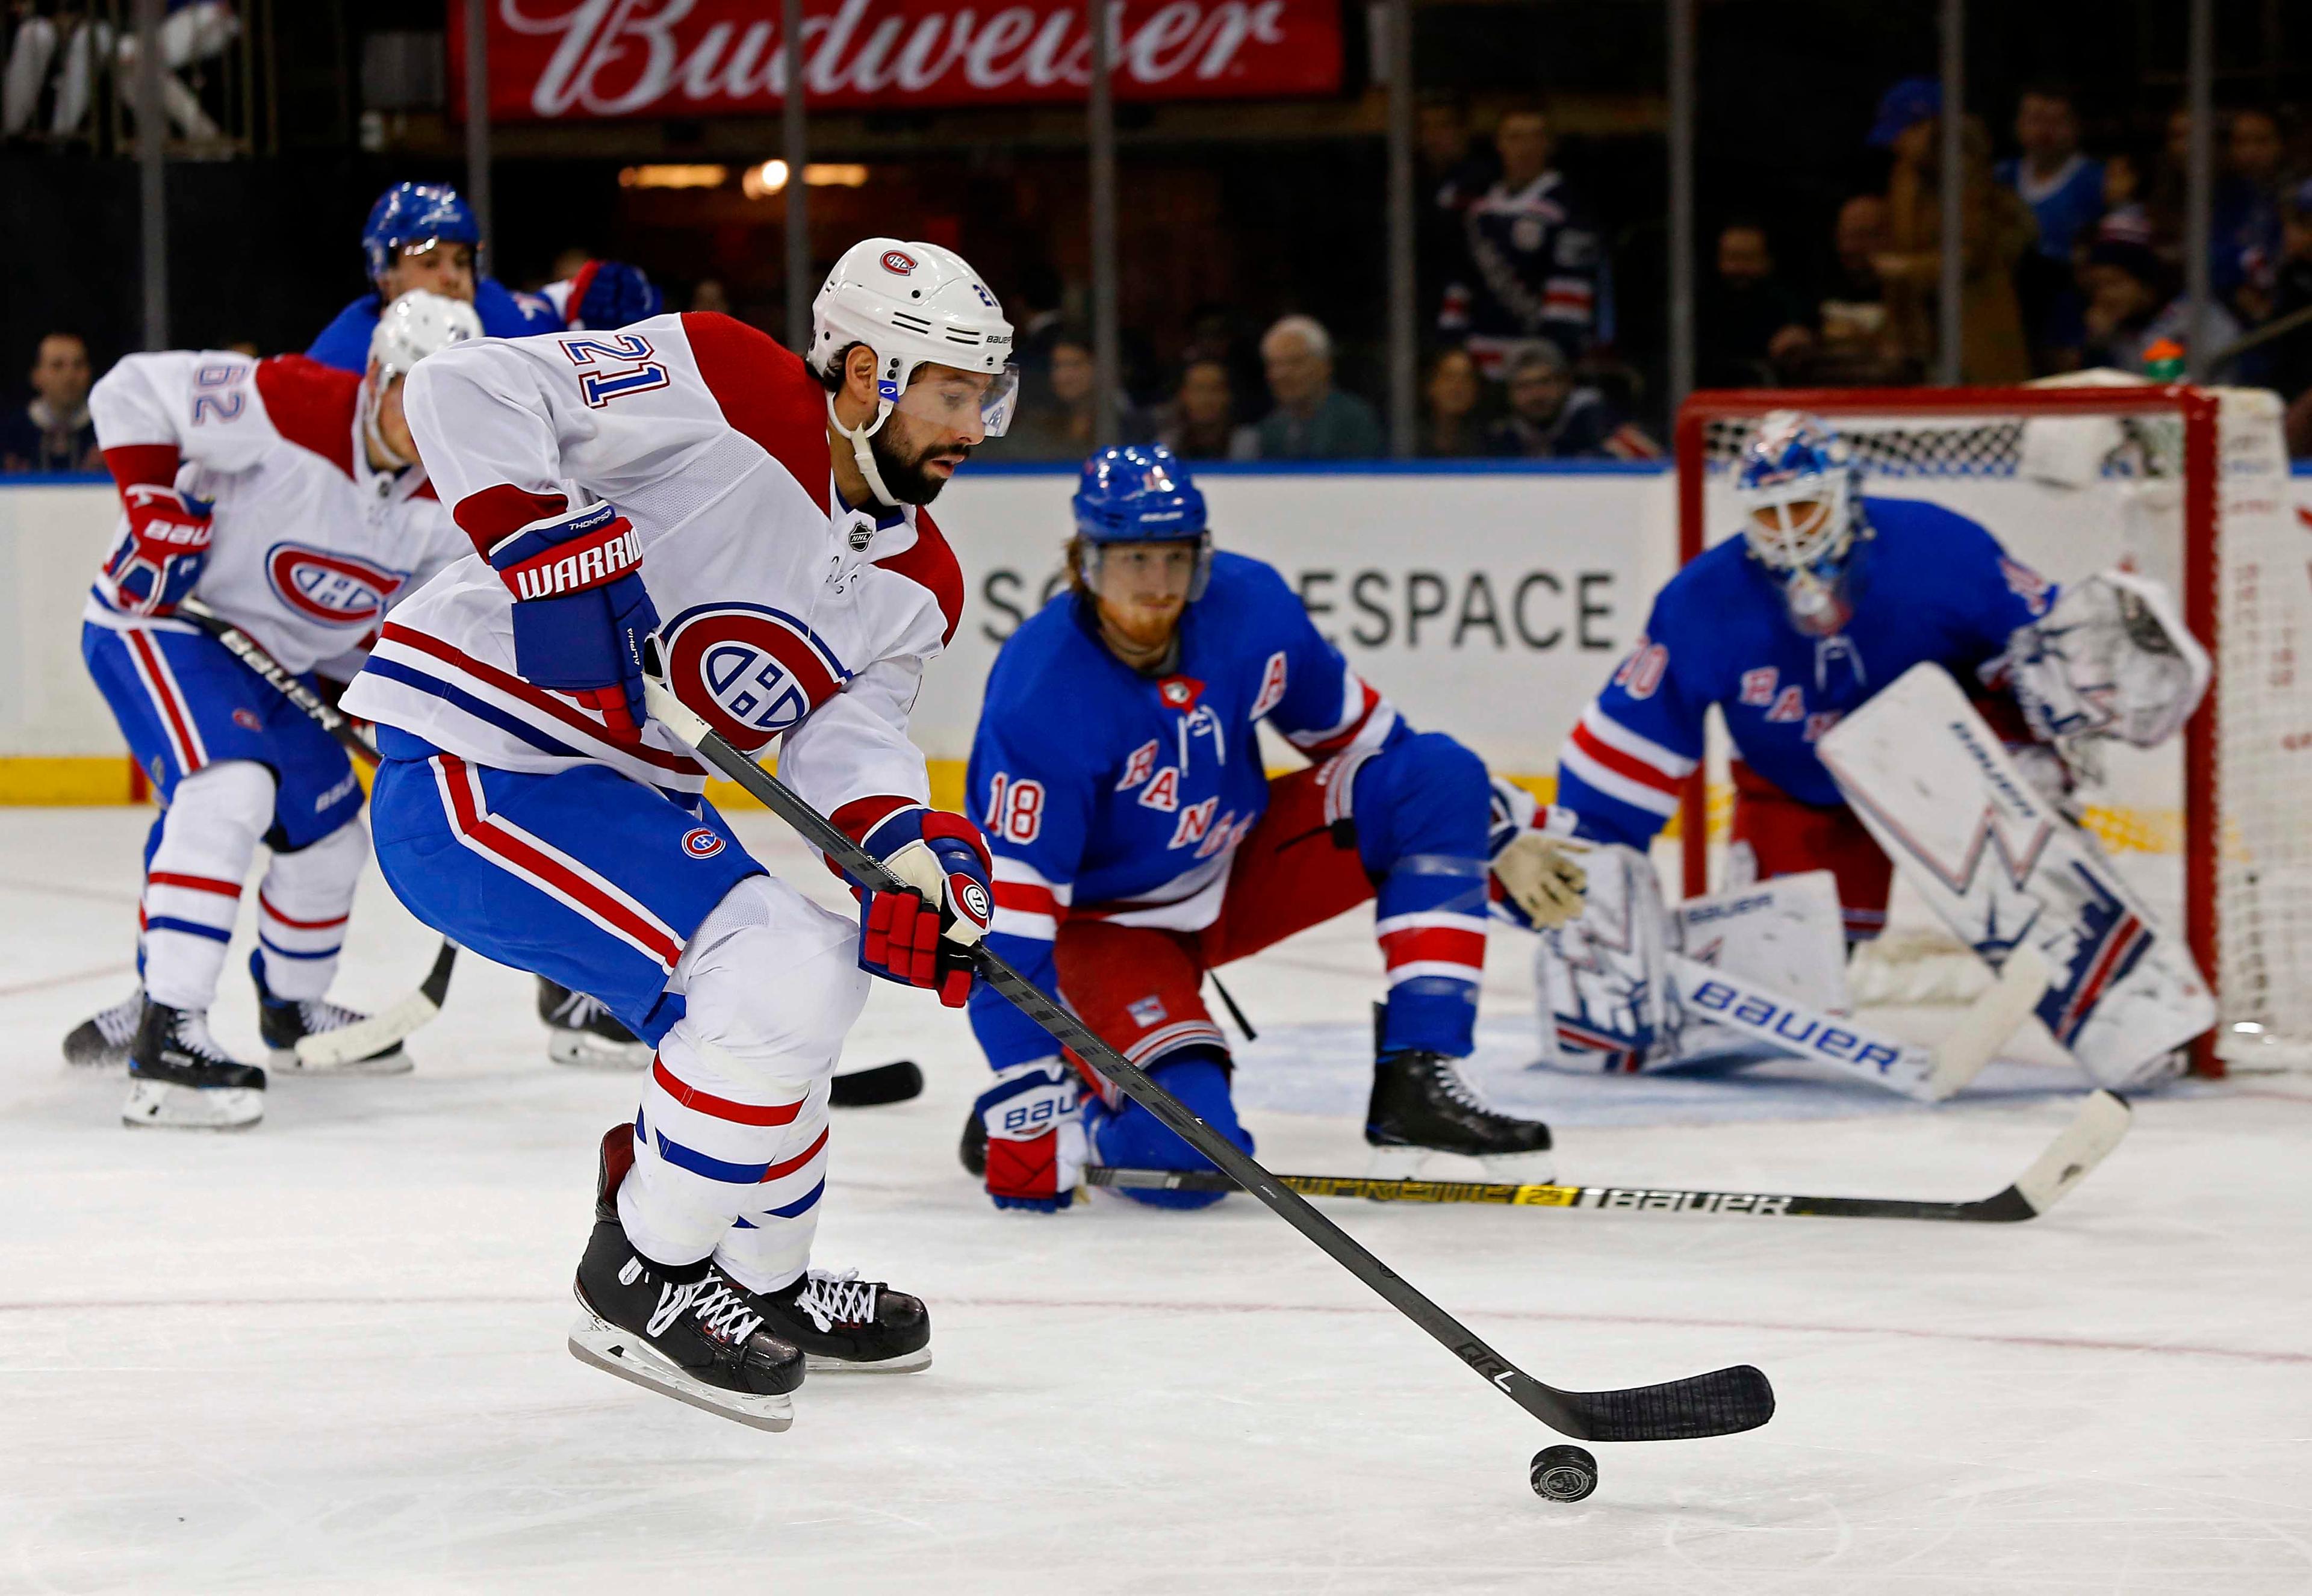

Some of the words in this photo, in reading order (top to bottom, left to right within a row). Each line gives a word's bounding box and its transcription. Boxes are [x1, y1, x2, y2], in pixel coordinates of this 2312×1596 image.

[500, 0, 1284, 116] Budweiser
[558, 334, 671, 409] 21
[851, 533, 868, 542] NHL
[627, 627, 639, 665] ALPHA
[1248, 650, 1287, 722] A
[984, 771, 1046, 846] 18
[1691, 980, 1901, 1075] BAUER
